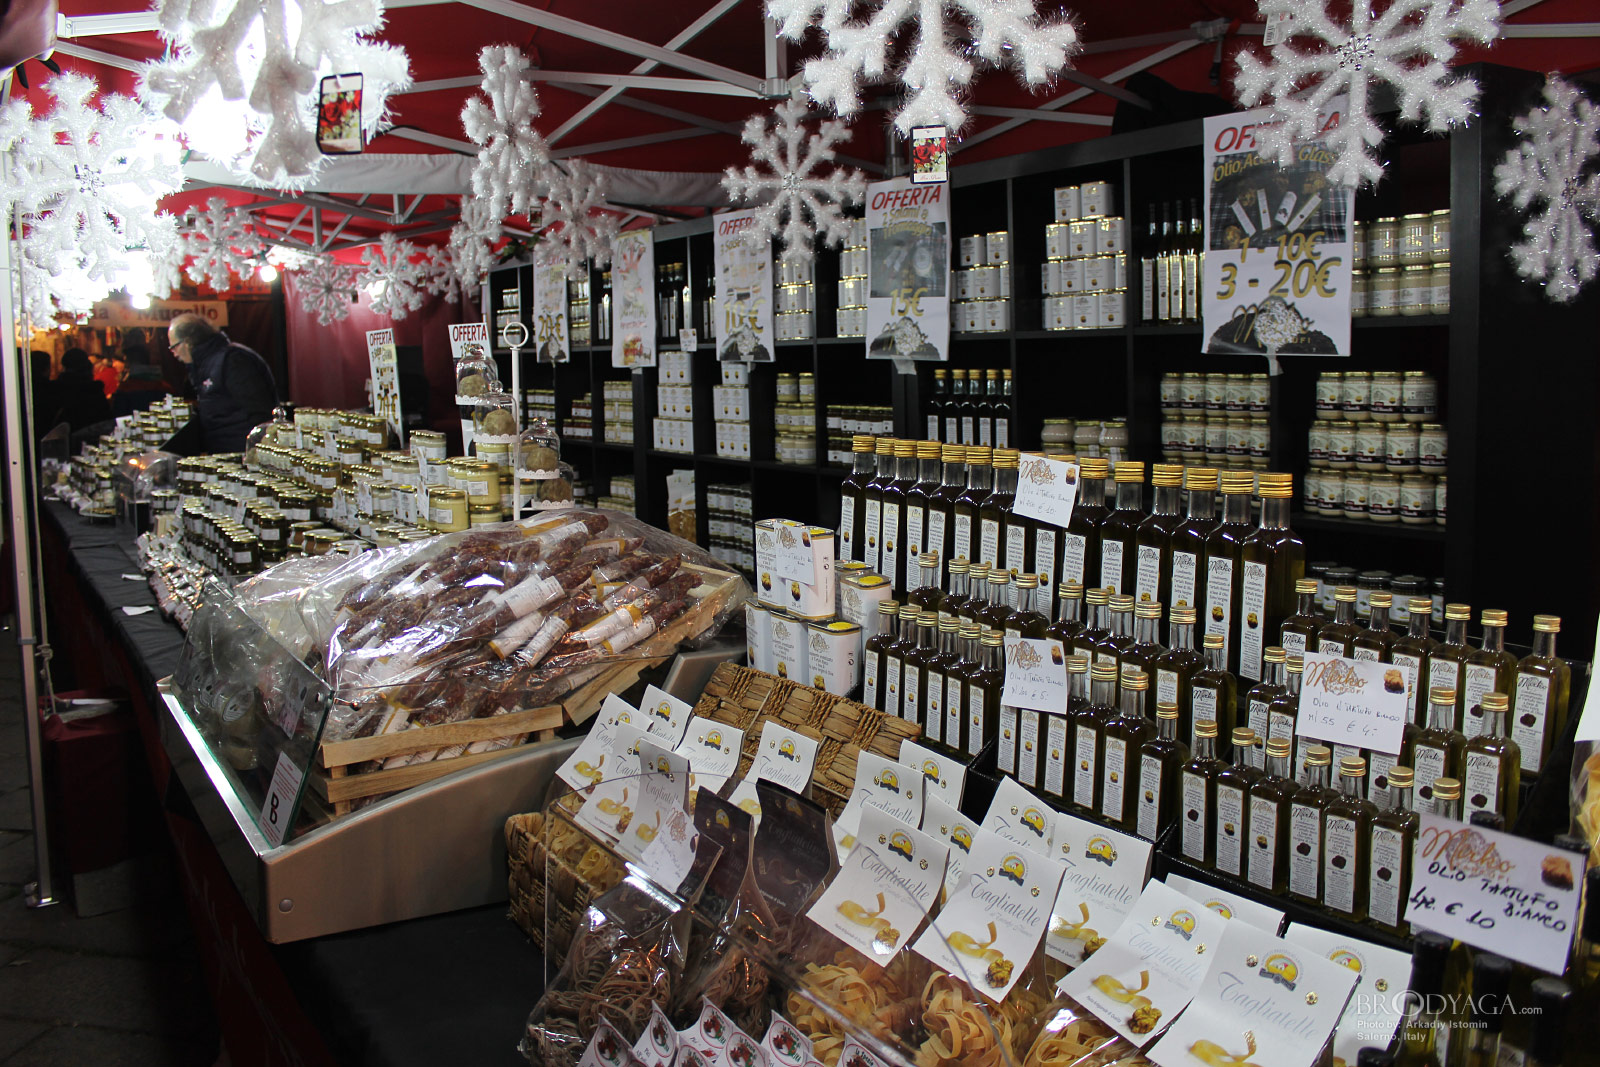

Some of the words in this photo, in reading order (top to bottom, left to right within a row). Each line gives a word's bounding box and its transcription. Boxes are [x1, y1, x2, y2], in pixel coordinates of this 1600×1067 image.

[871, 185, 942, 211] OFFERTA
[1240, 237, 1250, 264] 1
[1276, 230, 1325, 262] 10€
[1216, 262, 1238, 300] 3
[1268, 256, 1342, 299] 20€
[724, 297, 766, 334] 10€
[890, 287, 928, 317] 15€
[370, 330, 392, 347] OFFERTA
[452, 324, 487, 342] OFFERTA
[1321, 716, 1334, 726] 55
[1346, 720, 1356, 732] €
[760, 755, 804, 790] Tagliatelle
[860, 845, 930, 900] Tagliatelle
[1059, 858, 1133, 904] Tagliatelle
[970, 873, 1041, 927] Tagliatelle
[1480, 878, 1558, 911] TARTUFO
[1444, 902, 1464, 916] €
[1466, 910, 1496, 929] 10
[1218, 971, 1321, 1040] Tagliatelle
